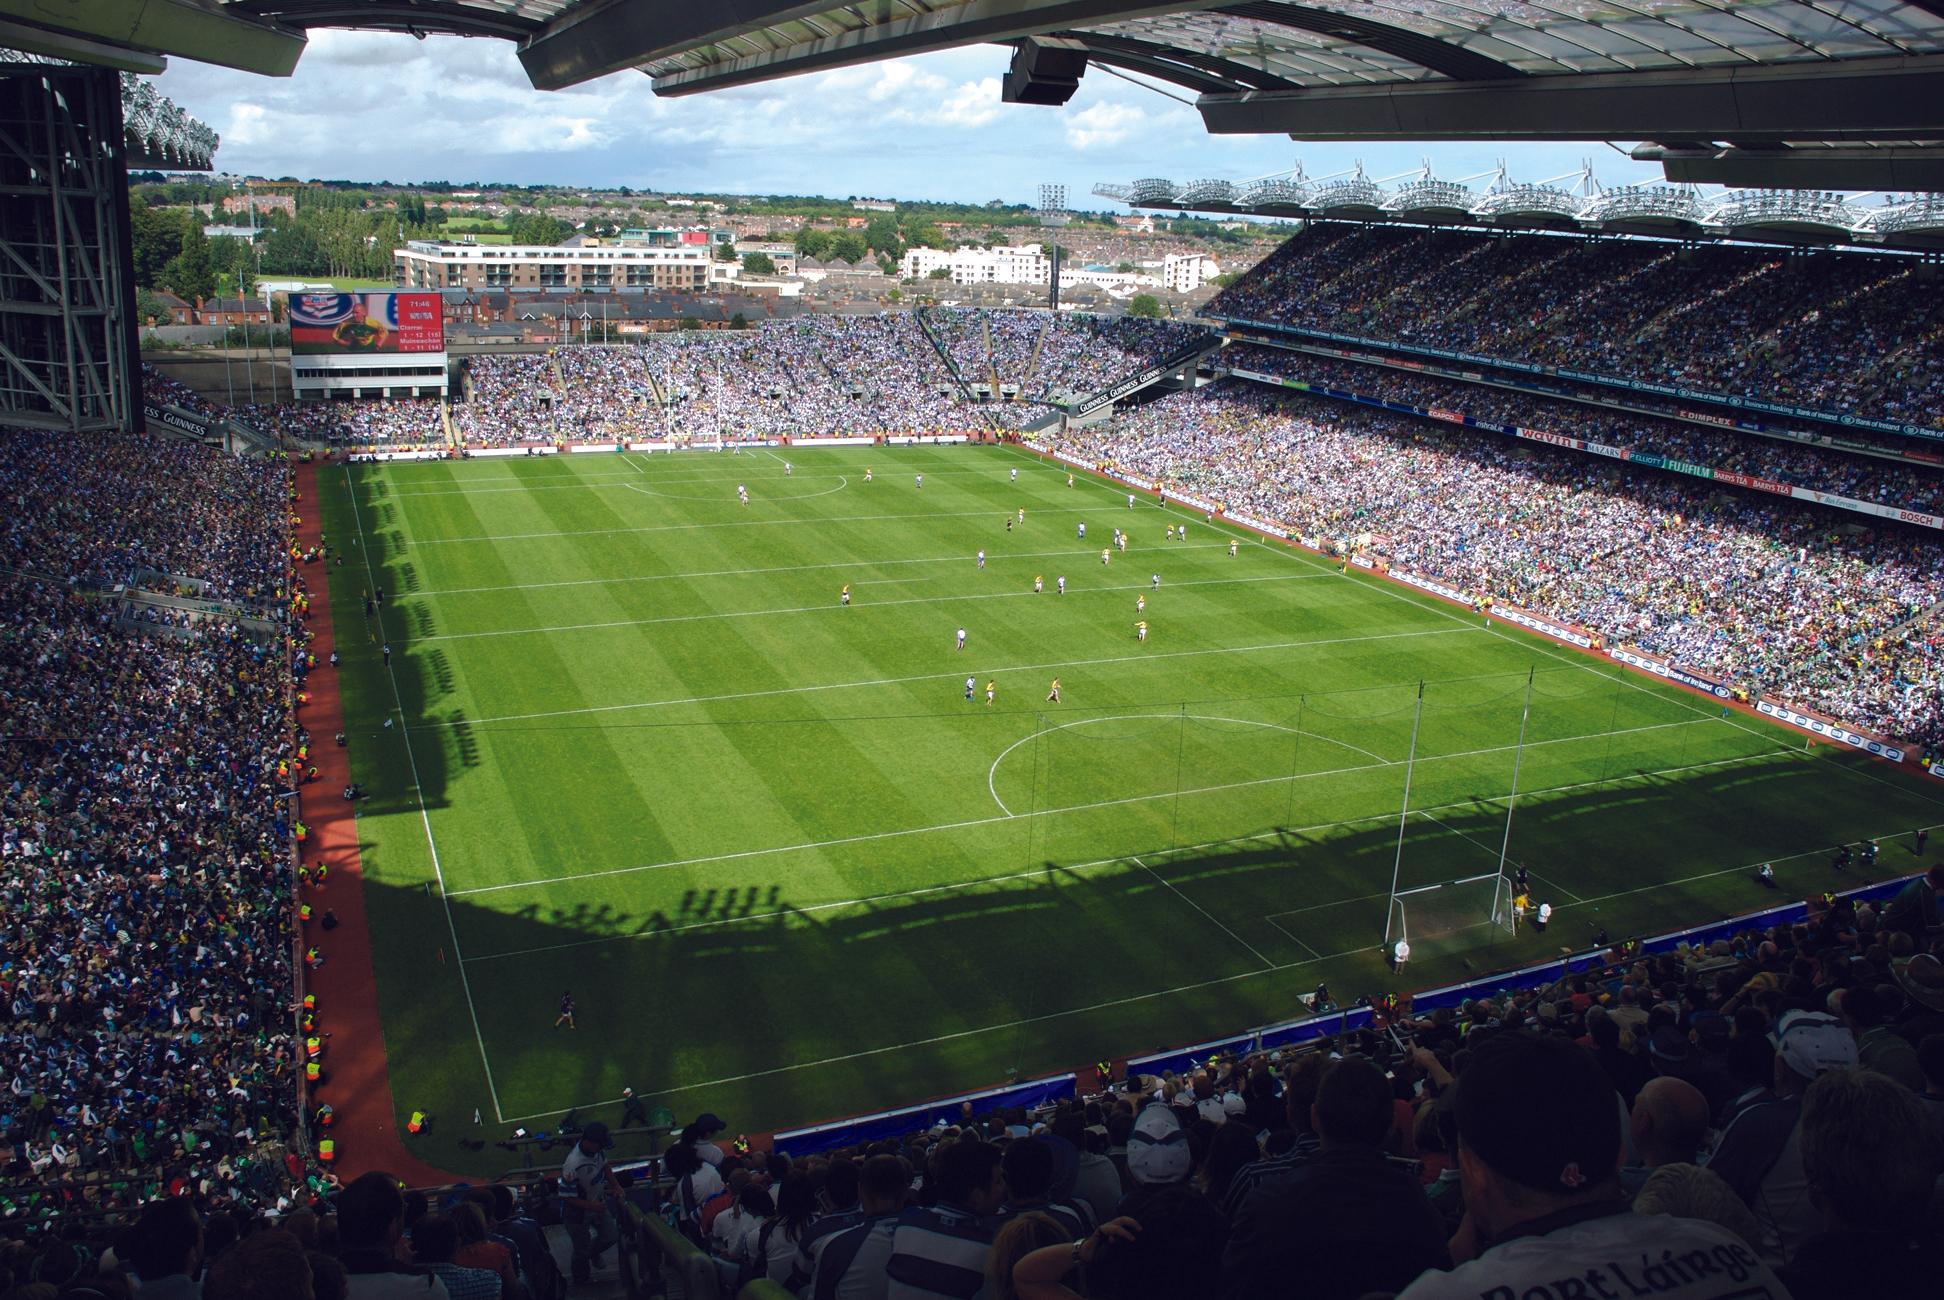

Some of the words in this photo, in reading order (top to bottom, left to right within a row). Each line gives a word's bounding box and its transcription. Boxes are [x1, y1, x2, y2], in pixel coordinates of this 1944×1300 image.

[1110, 381, 1138, 397] GUINNESS
[1080, 394, 1108, 413] GUINNESS
[1688, 412, 1729, 425] DIMPLEX
[1796, 408, 1810, 416] Bank
[1818, 412, 1838, 421] Ireland
[163, 412, 207, 436] GUINNESS
[1856, 417, 1871, 426] Bank
[1878, 422, 1900, 431] Ireland
[1522, 429, 1571, 447] wavin
[1920, 428, 1936, 437] Bank
[1588, 443, 1619, 457] MAZARS
[1669, 460, 1709, 478] FUJIFILM
[1736, 477, 1747, 485] TEA
[1777, 486, 1788, 494] TEA
[1900, 511, 1933, 525] BOSCH
[1668, 671, 1683, 681] Bank
[1691, 678, 1712, 691] Ireland
[1608, 1243, 1757, 1297] Láirge
